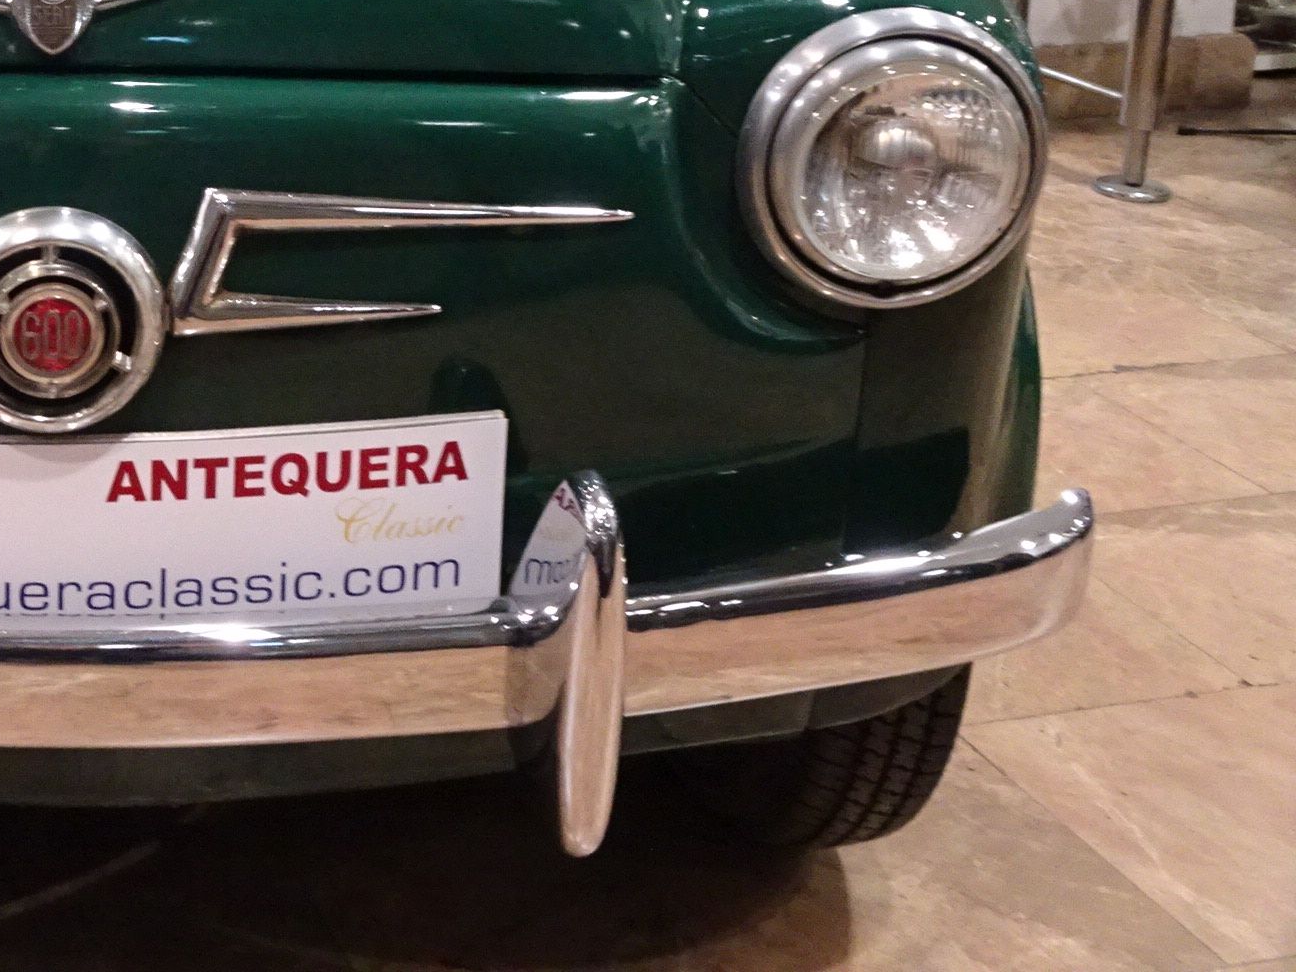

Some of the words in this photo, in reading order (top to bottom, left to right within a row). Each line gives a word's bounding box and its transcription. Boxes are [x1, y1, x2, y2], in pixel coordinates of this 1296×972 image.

[21, 309, 83, 361] 600
[106, 441, 469, 503] ANTEQUERA
[334, 496, 464, 545] Classic
